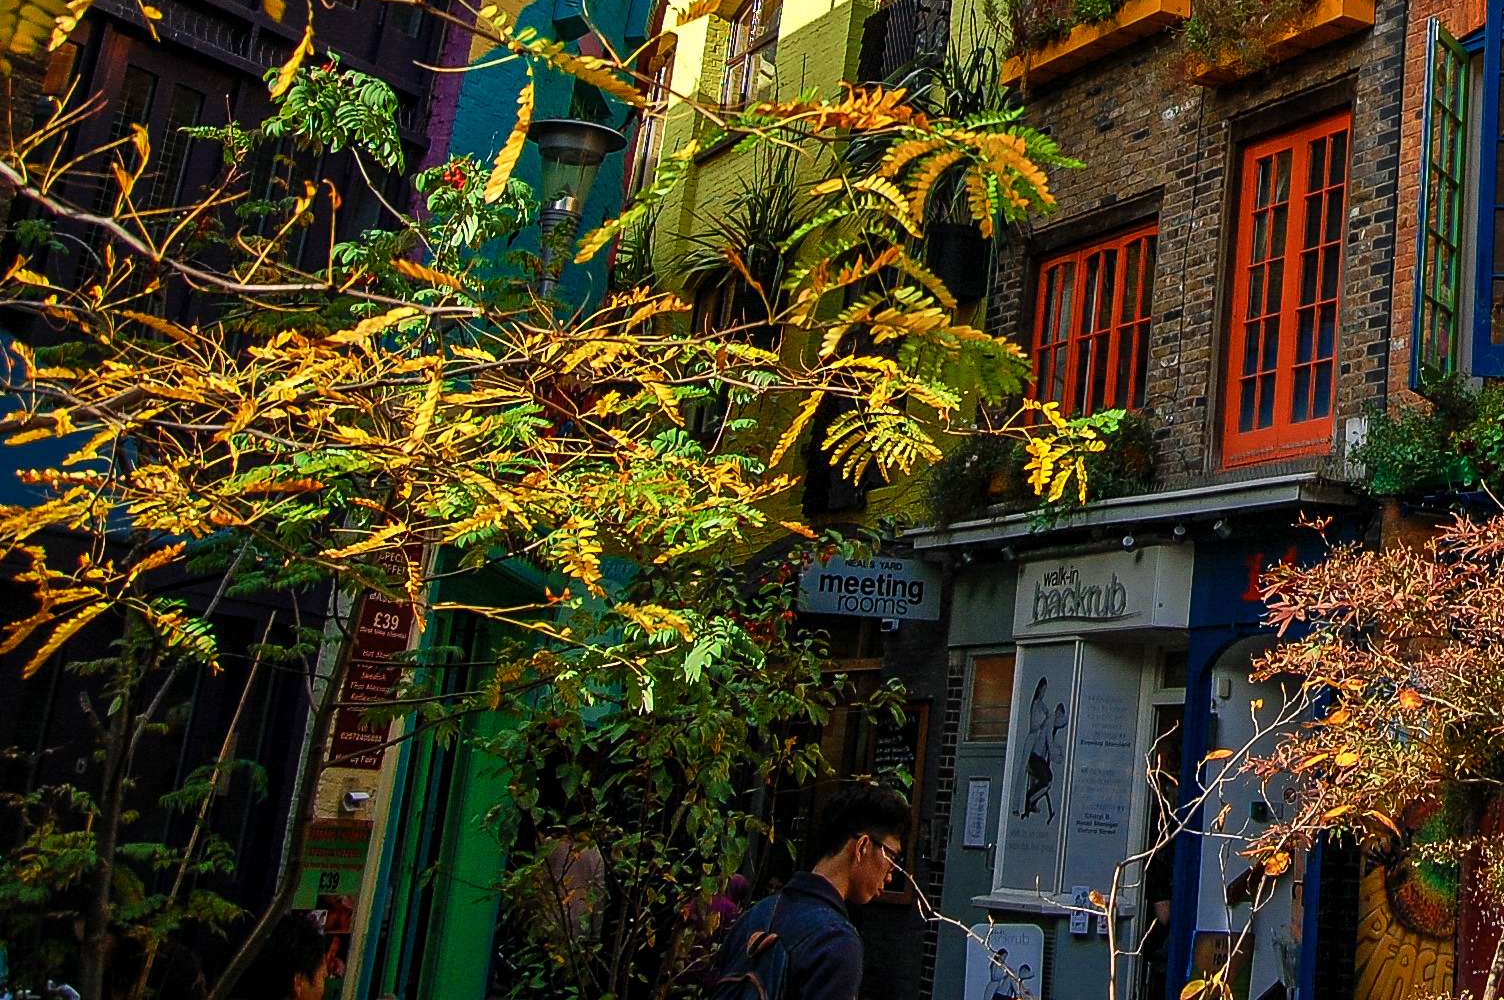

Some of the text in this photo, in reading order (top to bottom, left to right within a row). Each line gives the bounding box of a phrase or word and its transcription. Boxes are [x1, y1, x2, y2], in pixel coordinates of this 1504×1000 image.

[880, 561, 903, 571] YARD
[1043, 565, 1080, 587] walk-in
[819, 574, 924, 605] meeting
[1031, 571, 1128, 621] backrub
[838, 594, 908, 615] rooms
[373, 611, 400, 631] £39
